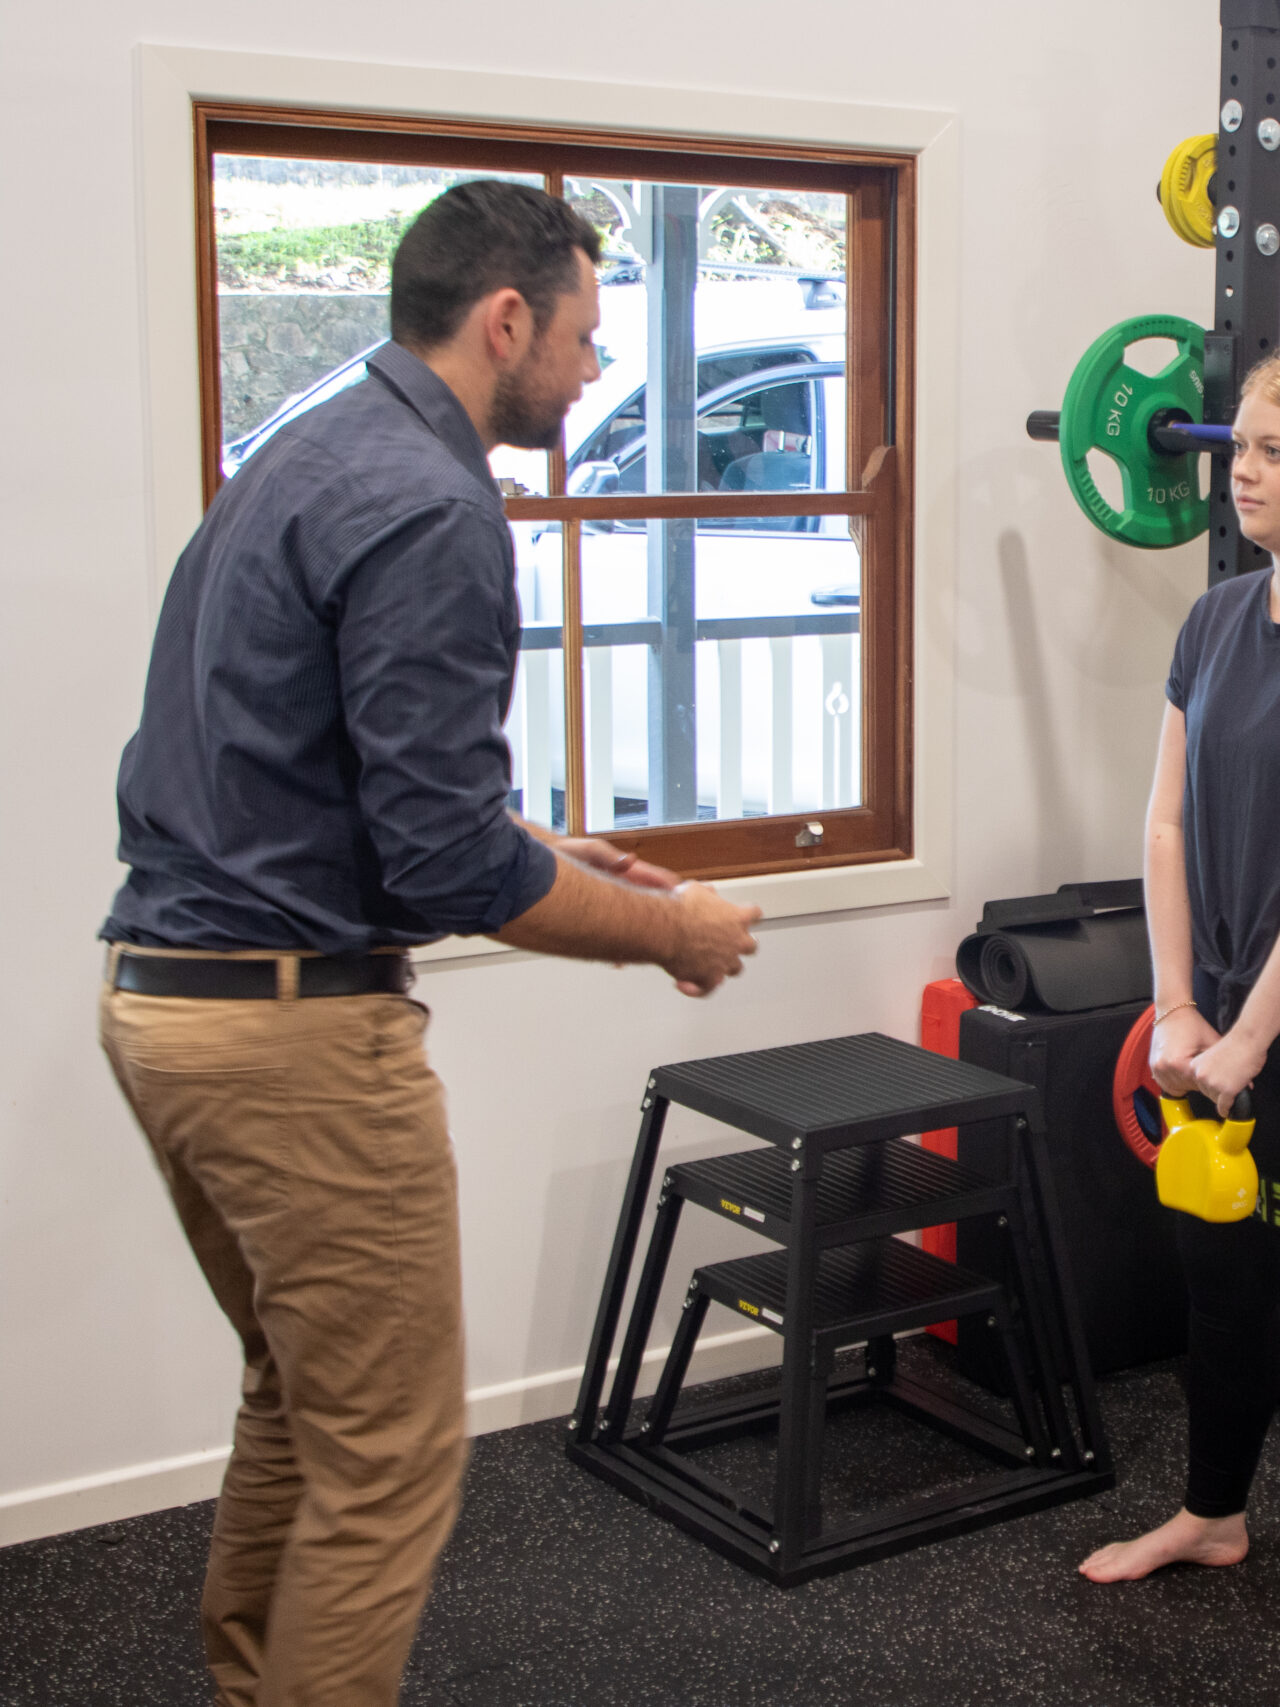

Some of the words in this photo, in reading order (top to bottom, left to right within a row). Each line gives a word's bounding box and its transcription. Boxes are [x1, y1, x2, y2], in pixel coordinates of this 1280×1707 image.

[1115, 383, 1134, 407] 10
[1106, 409, 1122, 436] KG
[1147, 488, 1166, 504] 10
[1169, 481, 1190, 501] KG
